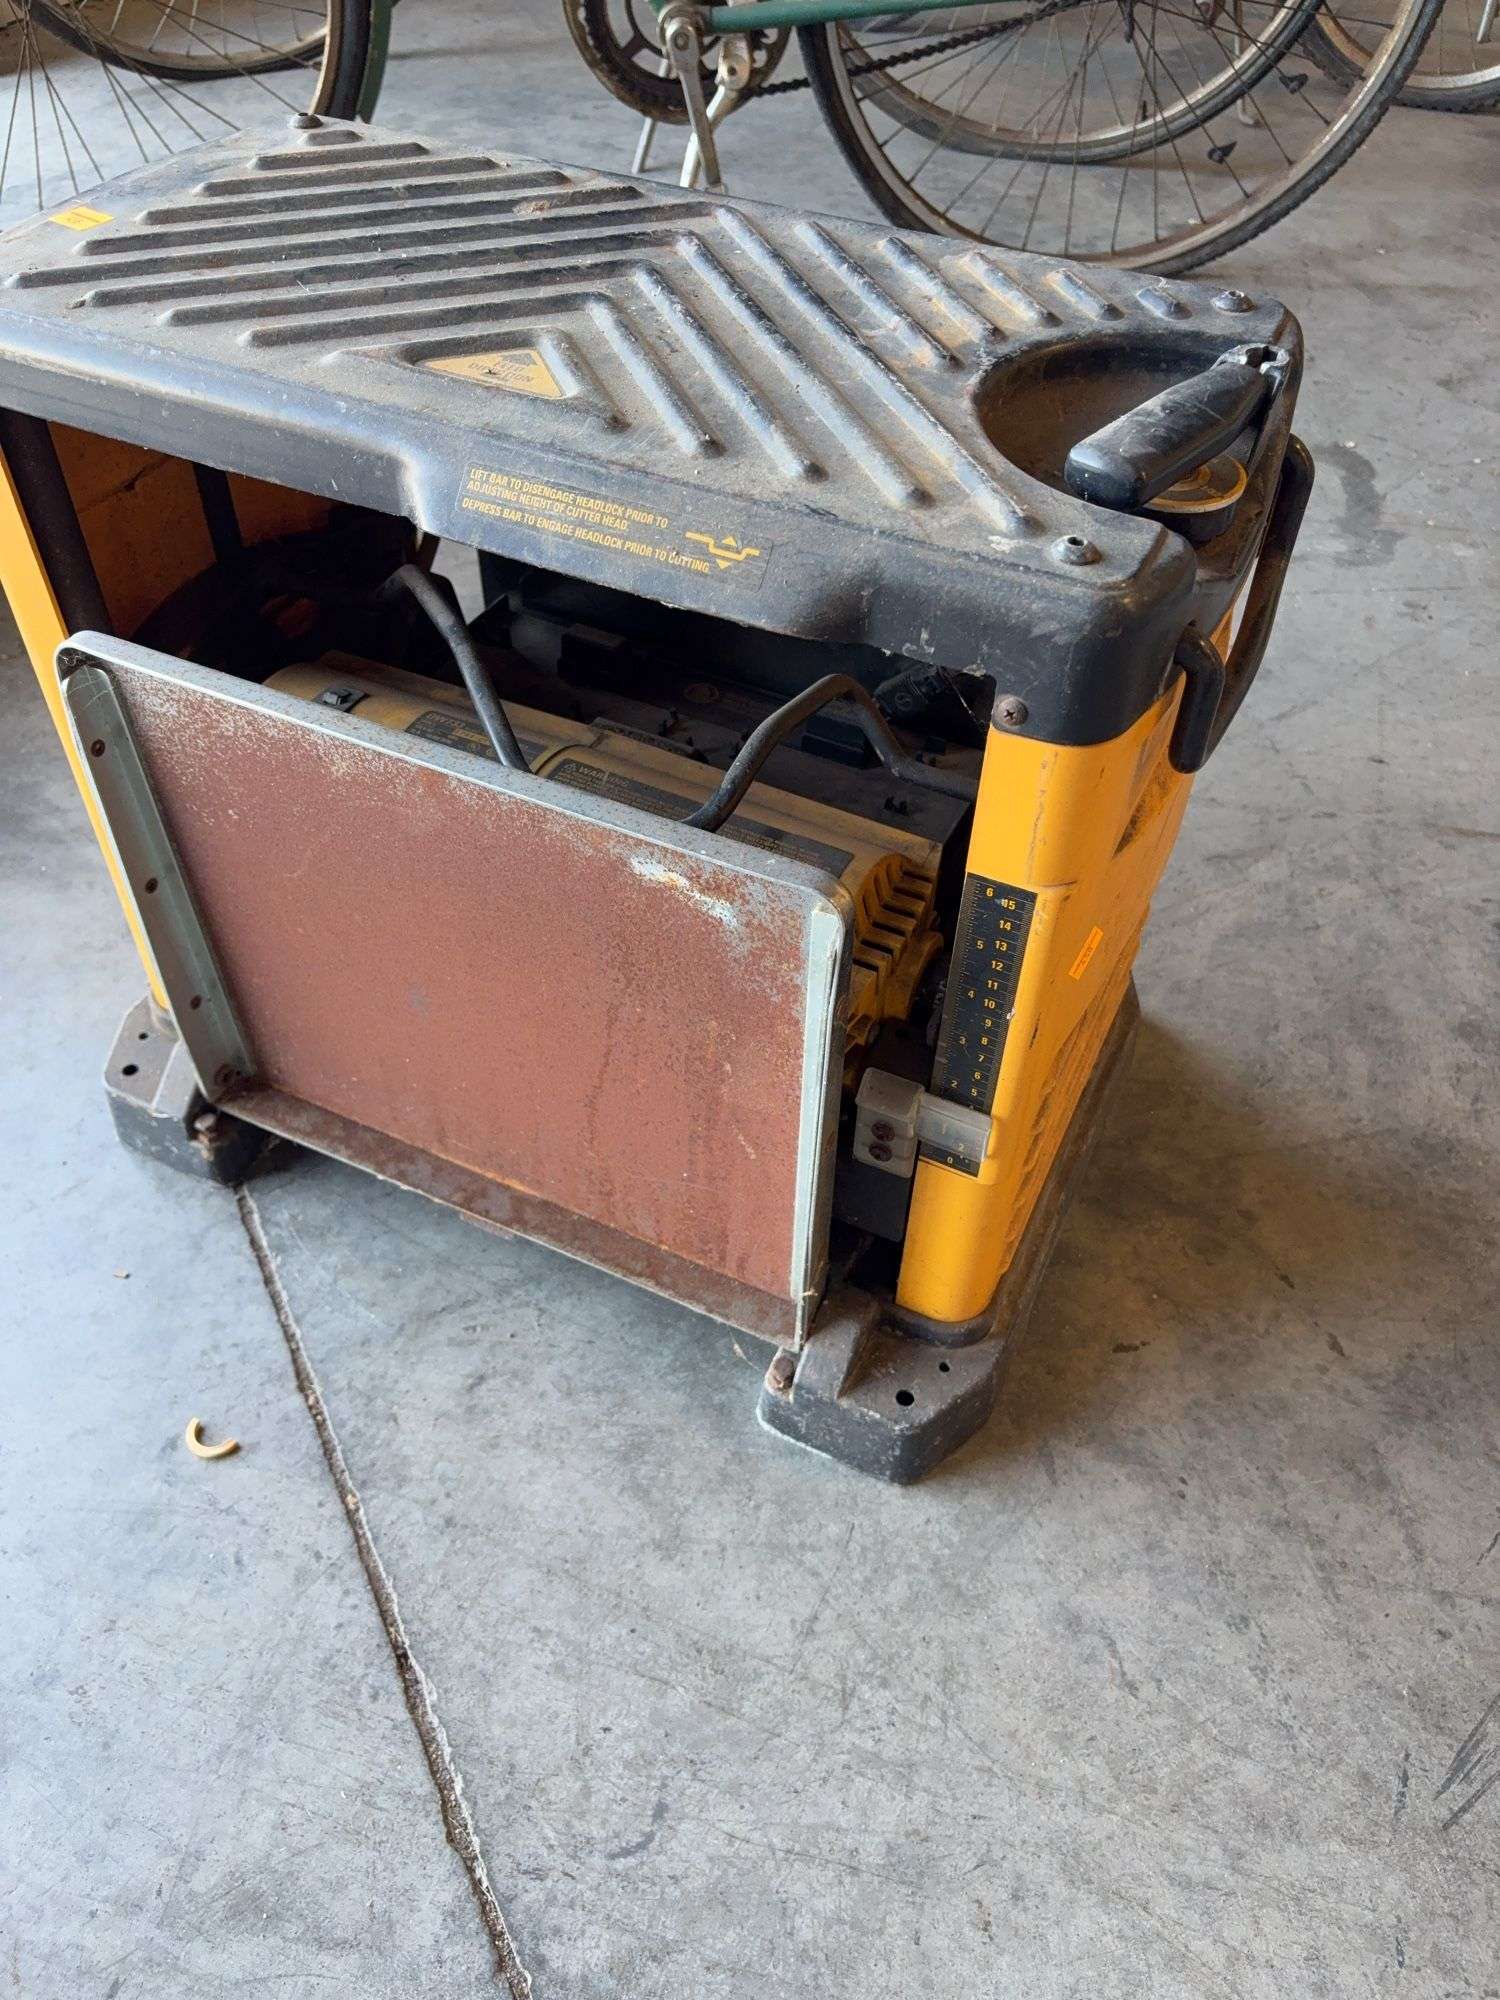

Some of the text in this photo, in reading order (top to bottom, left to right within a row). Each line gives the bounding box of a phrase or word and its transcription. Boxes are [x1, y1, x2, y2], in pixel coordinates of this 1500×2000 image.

[468, 362, 534, 383] DIRTION
[471, 468, 670, 529] LIFT BAR TO DISENGAGE HEADLOCK PRIOR TO
[466, 480, 629, 531] ADJUSTING HEIGHT OF CUTTER HEAD
[462, 497, 711, 574] DEPRESS BAR TO ENGAGE HEADLOCK PRIOR TO CUTTING
[578, 766, 630, 786] WARING
[985, 887, 995, 898] 6
[1000, 898, 1017, 911] 15
[999, 920, 1013, 932] 14
[976, 940, 985, 951] 5
[995, 940, 1009, 952] 13
[991, 960, 1005, 972] 12
[987, 980, 999, 991] 11
[967, 990, 976, 1000] 4
[983, 998, 997, 1010] 10
[984, 1018, 993, 1028] 9
[959, 1035, 967, 1045] 3
[980, 1036, 989, 1047] 8
[976, 1054, 986, 1063] 7
[973, 1071, 982, 1081] 6
[950, 1080, 959, 1089] 2
[969, 1088, 978, 1098] 5
